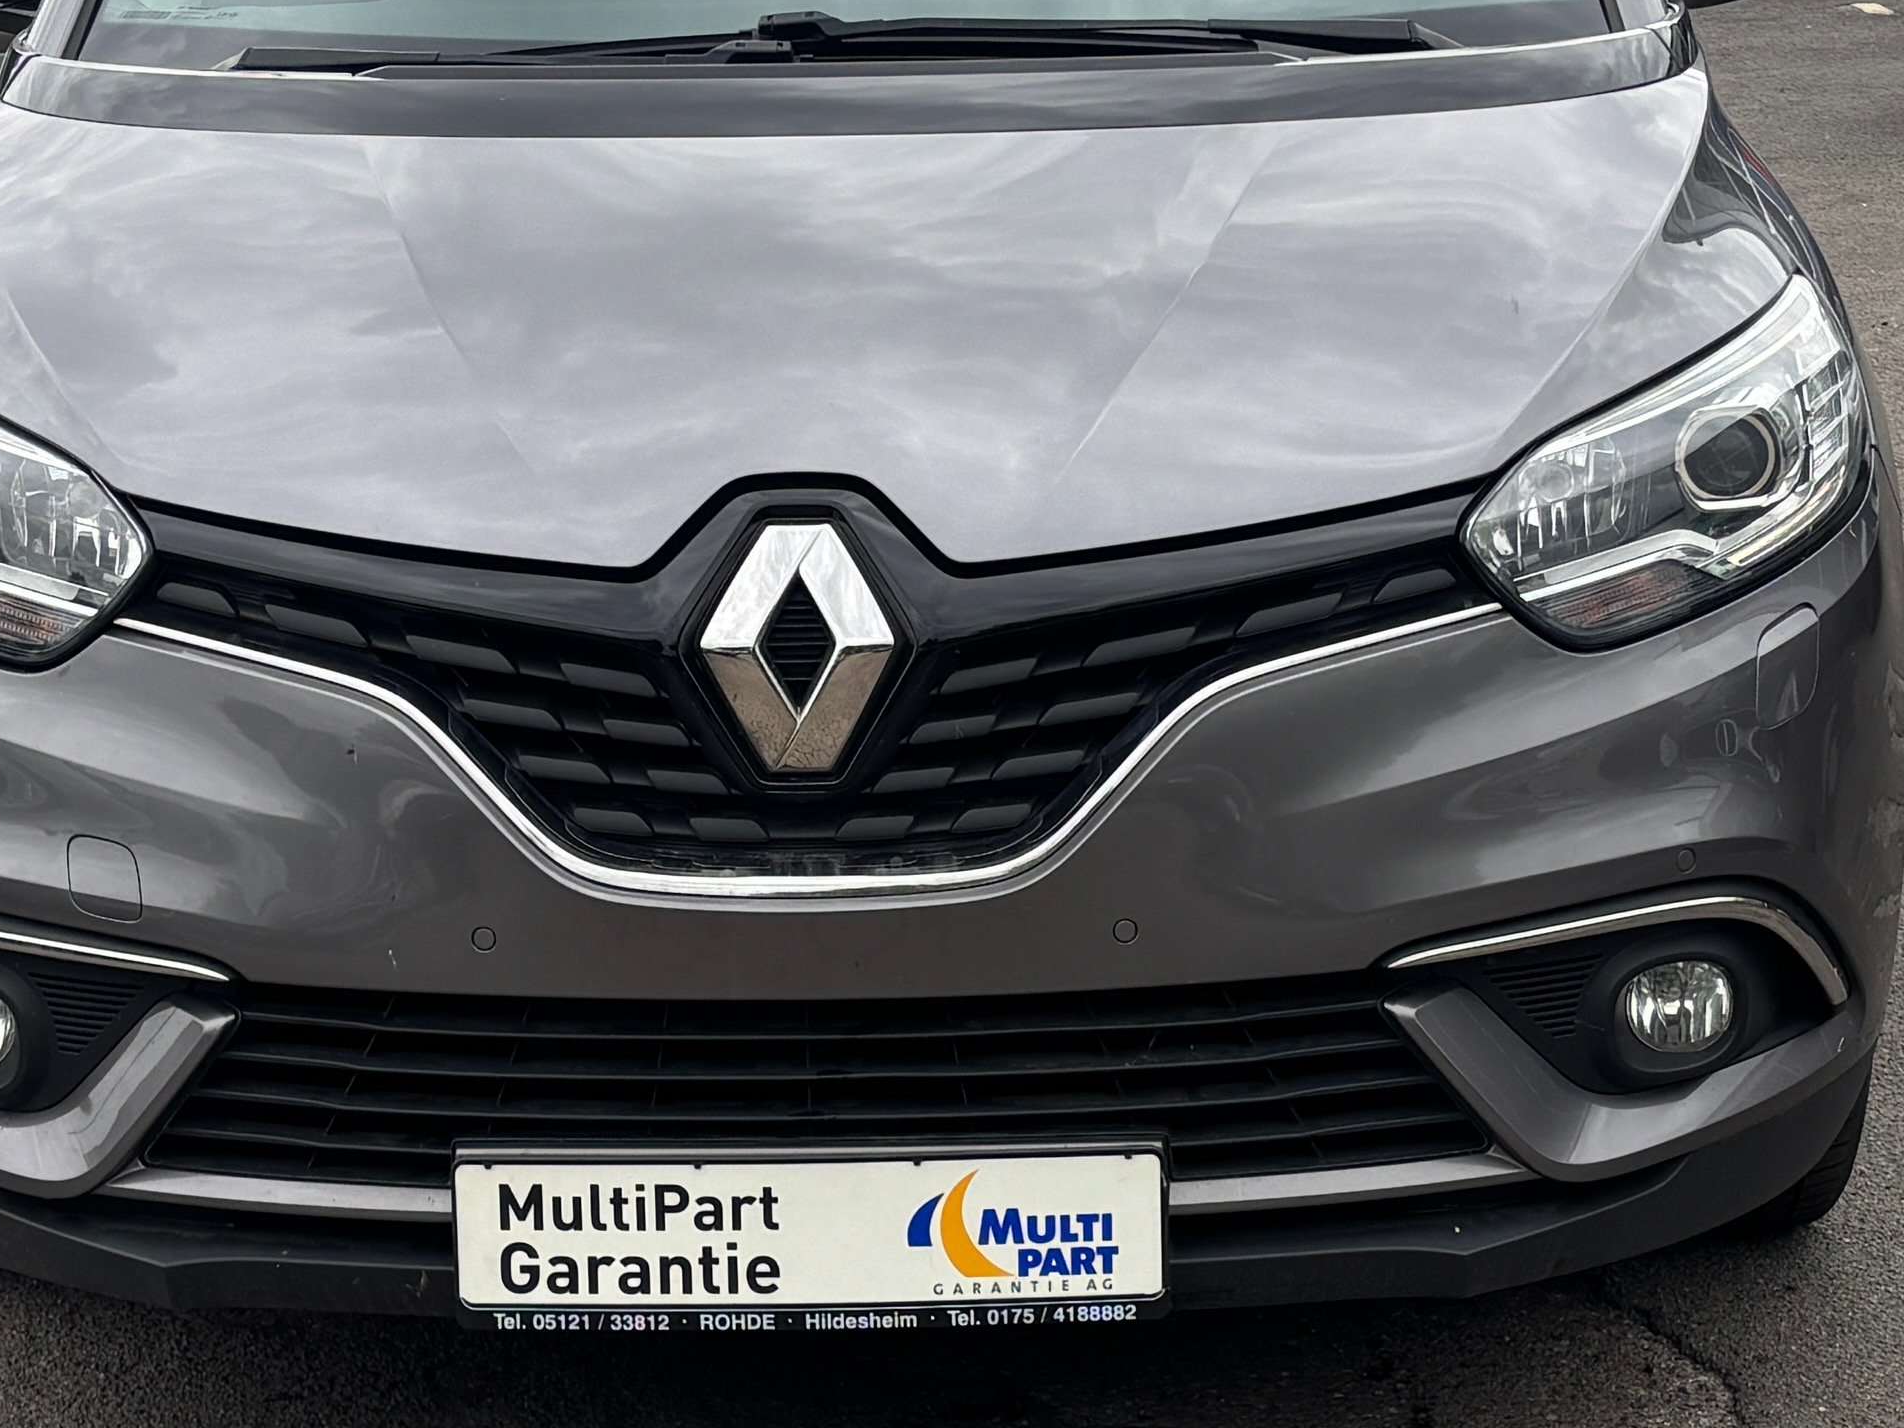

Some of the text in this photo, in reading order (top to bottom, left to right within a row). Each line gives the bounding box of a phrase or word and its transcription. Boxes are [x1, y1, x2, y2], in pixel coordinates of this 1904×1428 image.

[498, 1183, 780, 1232] MultiPart
[978, 1207, 1114, 1245] MULTI
[500, 1241, 781, 1295] Garantie
[1017, 1246, 1119, 1277] PART
[933, 1278, 1114, 1296] GARANTIE AG
[493, 1304, 1137, 1331] Tel. 05121 / 33812 ROHDE Hildesheim Tel. 0175 / 4188882
